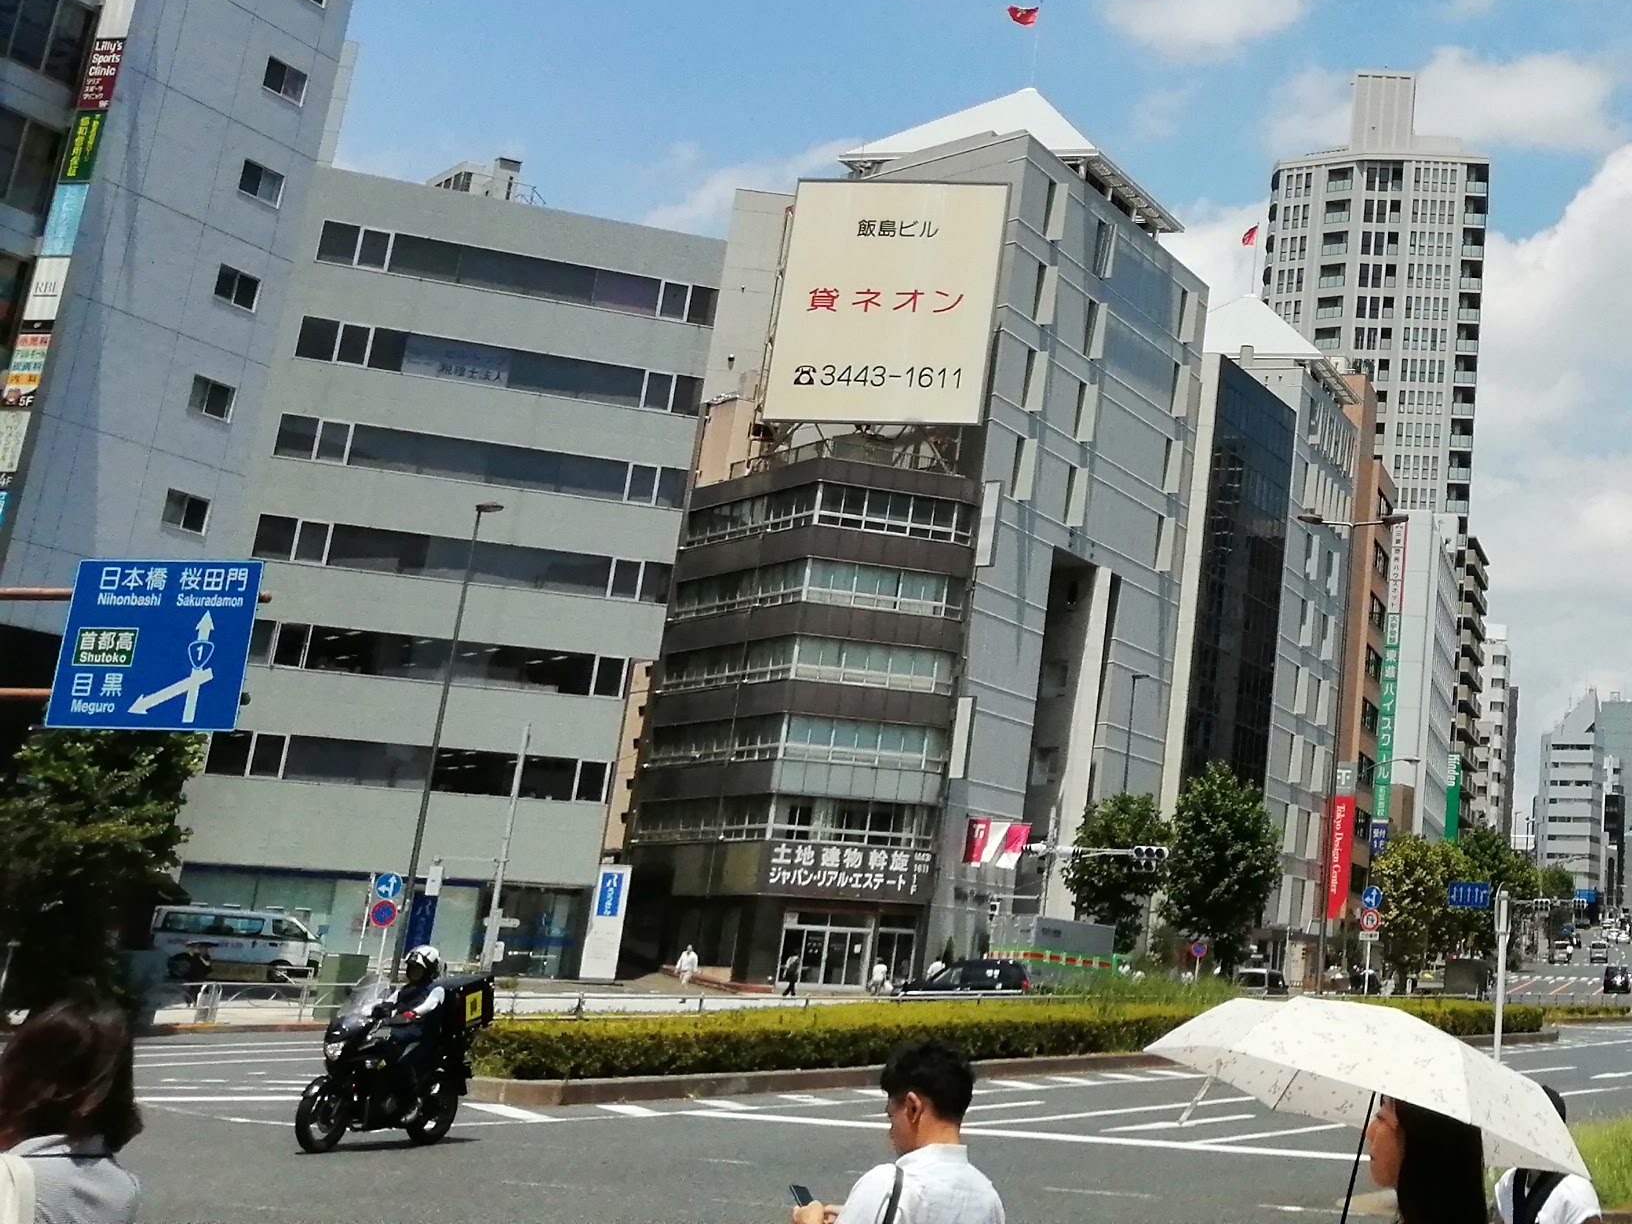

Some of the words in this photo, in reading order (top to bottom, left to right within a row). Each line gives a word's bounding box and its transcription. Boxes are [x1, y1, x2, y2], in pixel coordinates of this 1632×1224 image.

[92, 53, 121, 65] Sports
[95, 40, 123, 53] Lilly's
[89, 65, 116, 76] Clinic
[856, 219, 940, 238] 飯島ビル
[806, 287, 964, 313] 貸ネオン
[819, 364, 962, 389] 3443-1611
[18, 396, 34, 407] 5F
[99, 566, 168, 591] 日本橋
[179, 567, 249, 592] 桜田門
[96, 592, 162, 607] Nihonbashi
[176, 593, 244, 608] Sakuradamon
[79, 630, 135, 651] 首都高
[196, 645, 204, 661] 1
[79, 651, 127, 664] Shutoko
[71, 672, 124, 697] 目黒
[70, 698, 116, 715] Meguro
[1377, 648, 1398, 779] 東進ハイスクール
[1447, 754, 1461, 787] Kinden
[1334, 803, 1346, 831] Tokyo
[771, 843, 816, 867] 土地
[820, 846, 864, 869] 建物
[1331, 831, 1342, 864] Design
[769, 866, 907, 892] ジャパン・リアル・エステート
[1330, 864, 1342, 895] Center
